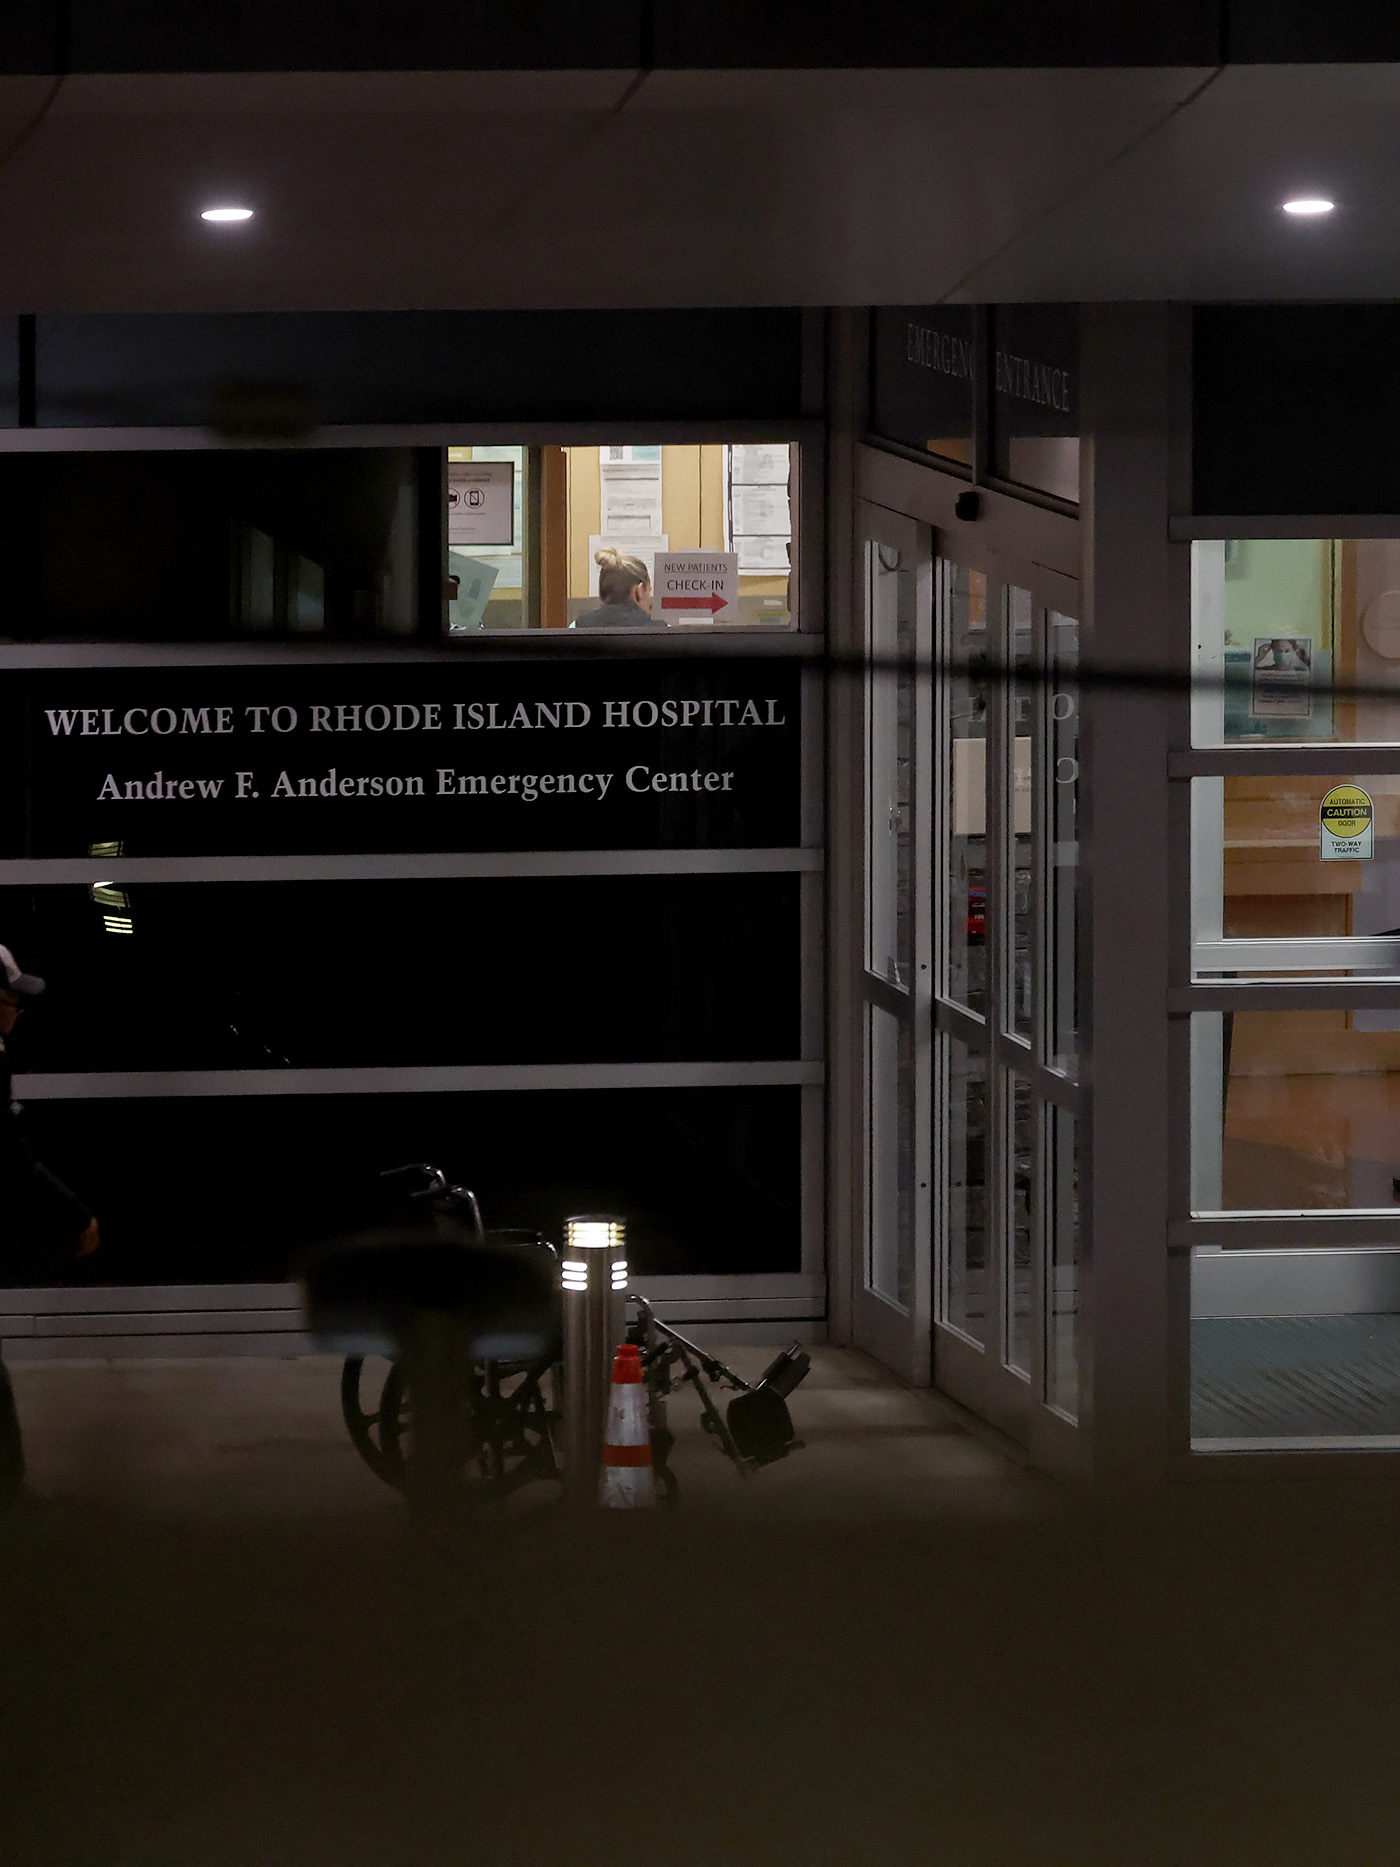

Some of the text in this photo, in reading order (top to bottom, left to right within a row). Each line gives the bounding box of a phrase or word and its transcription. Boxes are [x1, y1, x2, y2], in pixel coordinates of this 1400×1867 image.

[995, 351, 1070, 412] ENTRANCE
[664, 563, 728, 573] NEW PATIENTS
[667, 580, 724, 591] CHECK-IN
[45, 698, 786, 736] WELCOME TO RHODE ISLAND HOSPITAL
[97, 765, 735, 801] Andrew F. Anderson Emergency Center
[1327, 809, 1367, 817] CAUTION
